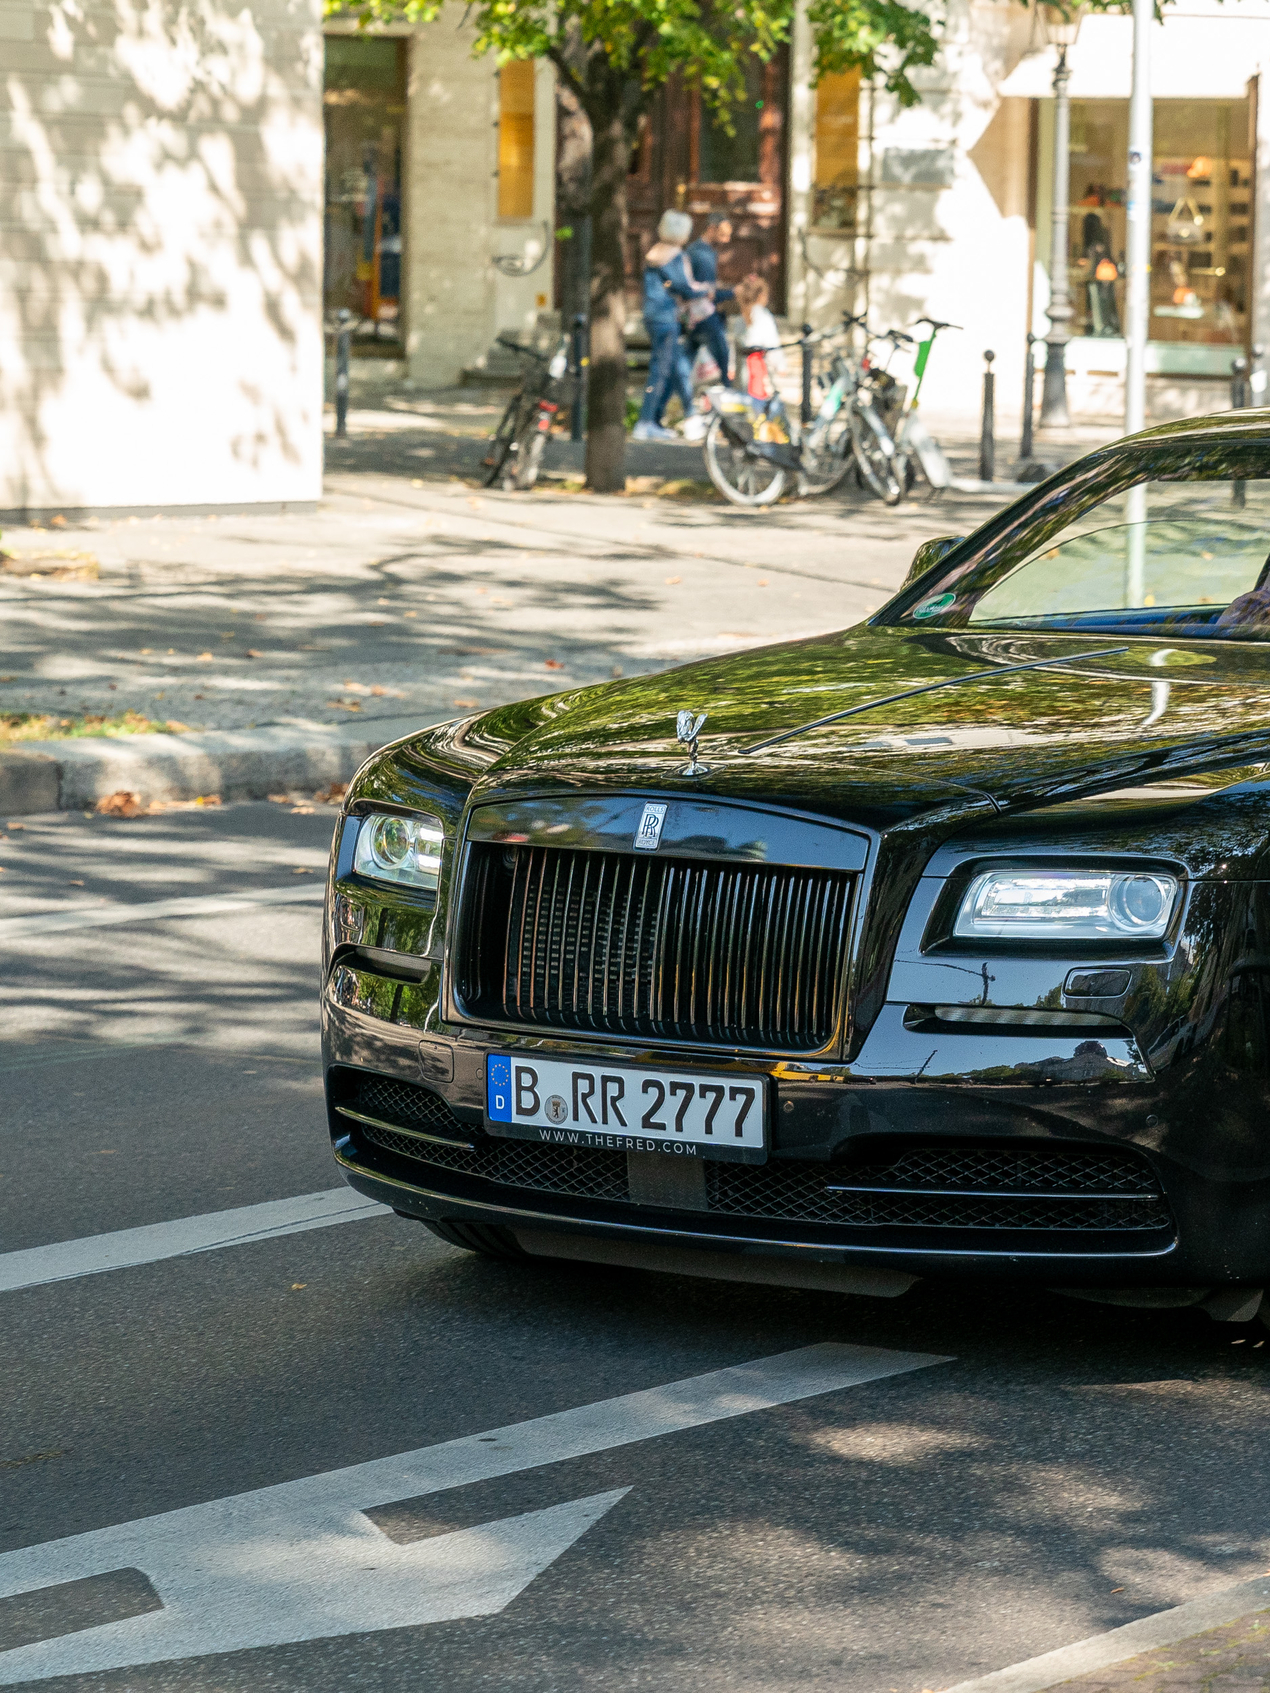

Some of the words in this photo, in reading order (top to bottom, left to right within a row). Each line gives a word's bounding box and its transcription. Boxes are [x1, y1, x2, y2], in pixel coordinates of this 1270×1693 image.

[495, 1095, 505, 1110] D
[515, 1065, 540, 1116] B
[571, 1071, 628, 1127] RR
[641, 1078, 756, 1138] 2777
[539, 1129, 697, 1156] WWW.THEFRED.COM
